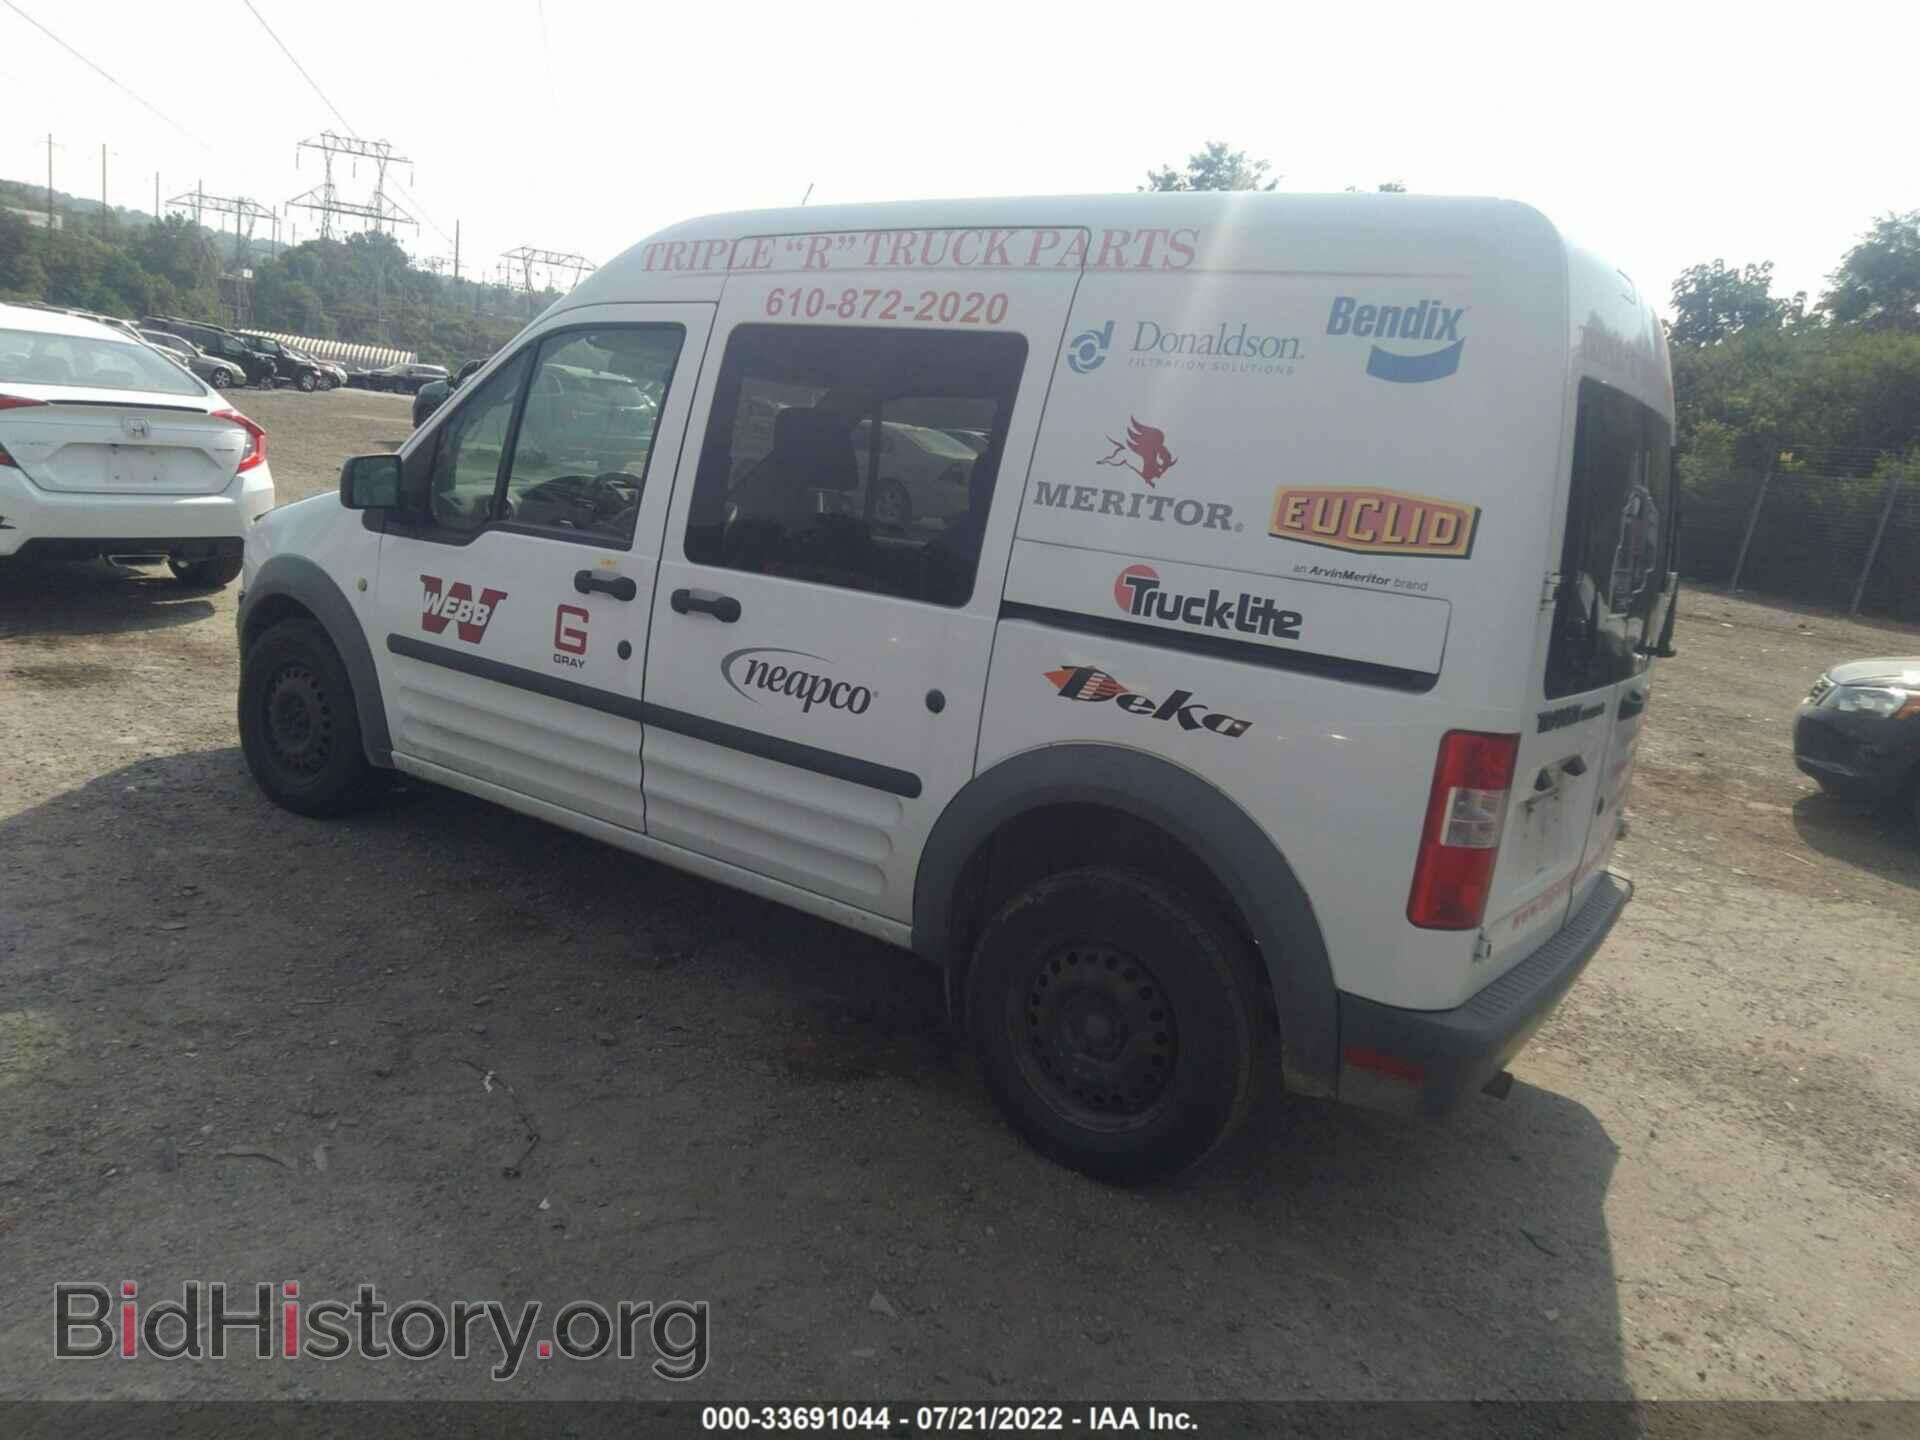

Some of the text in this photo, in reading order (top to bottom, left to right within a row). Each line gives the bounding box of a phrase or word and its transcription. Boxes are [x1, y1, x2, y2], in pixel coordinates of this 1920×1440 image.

[641, 238, 776, 272] TRIPLE
[863, 230, 1016, 268] TRUCK
[1024, 228, 1200, 270] PARTS
[765, 288, 1008, 325] 610-872-2020
[1326, 296, 1464, 342] Bendix
[1212, 361, 1294, 375] SOLUTIONS
[1282, 496, 1460, 546] EUCLID
[1309, 566, 1391, 586] ArvinMeritor
[1393, 579, 1428, 593] brand
[422, 592, 490, 627] WEBB
[553, 653, 586, 669] GRAY
[744, 657, 872, 714] neapco
